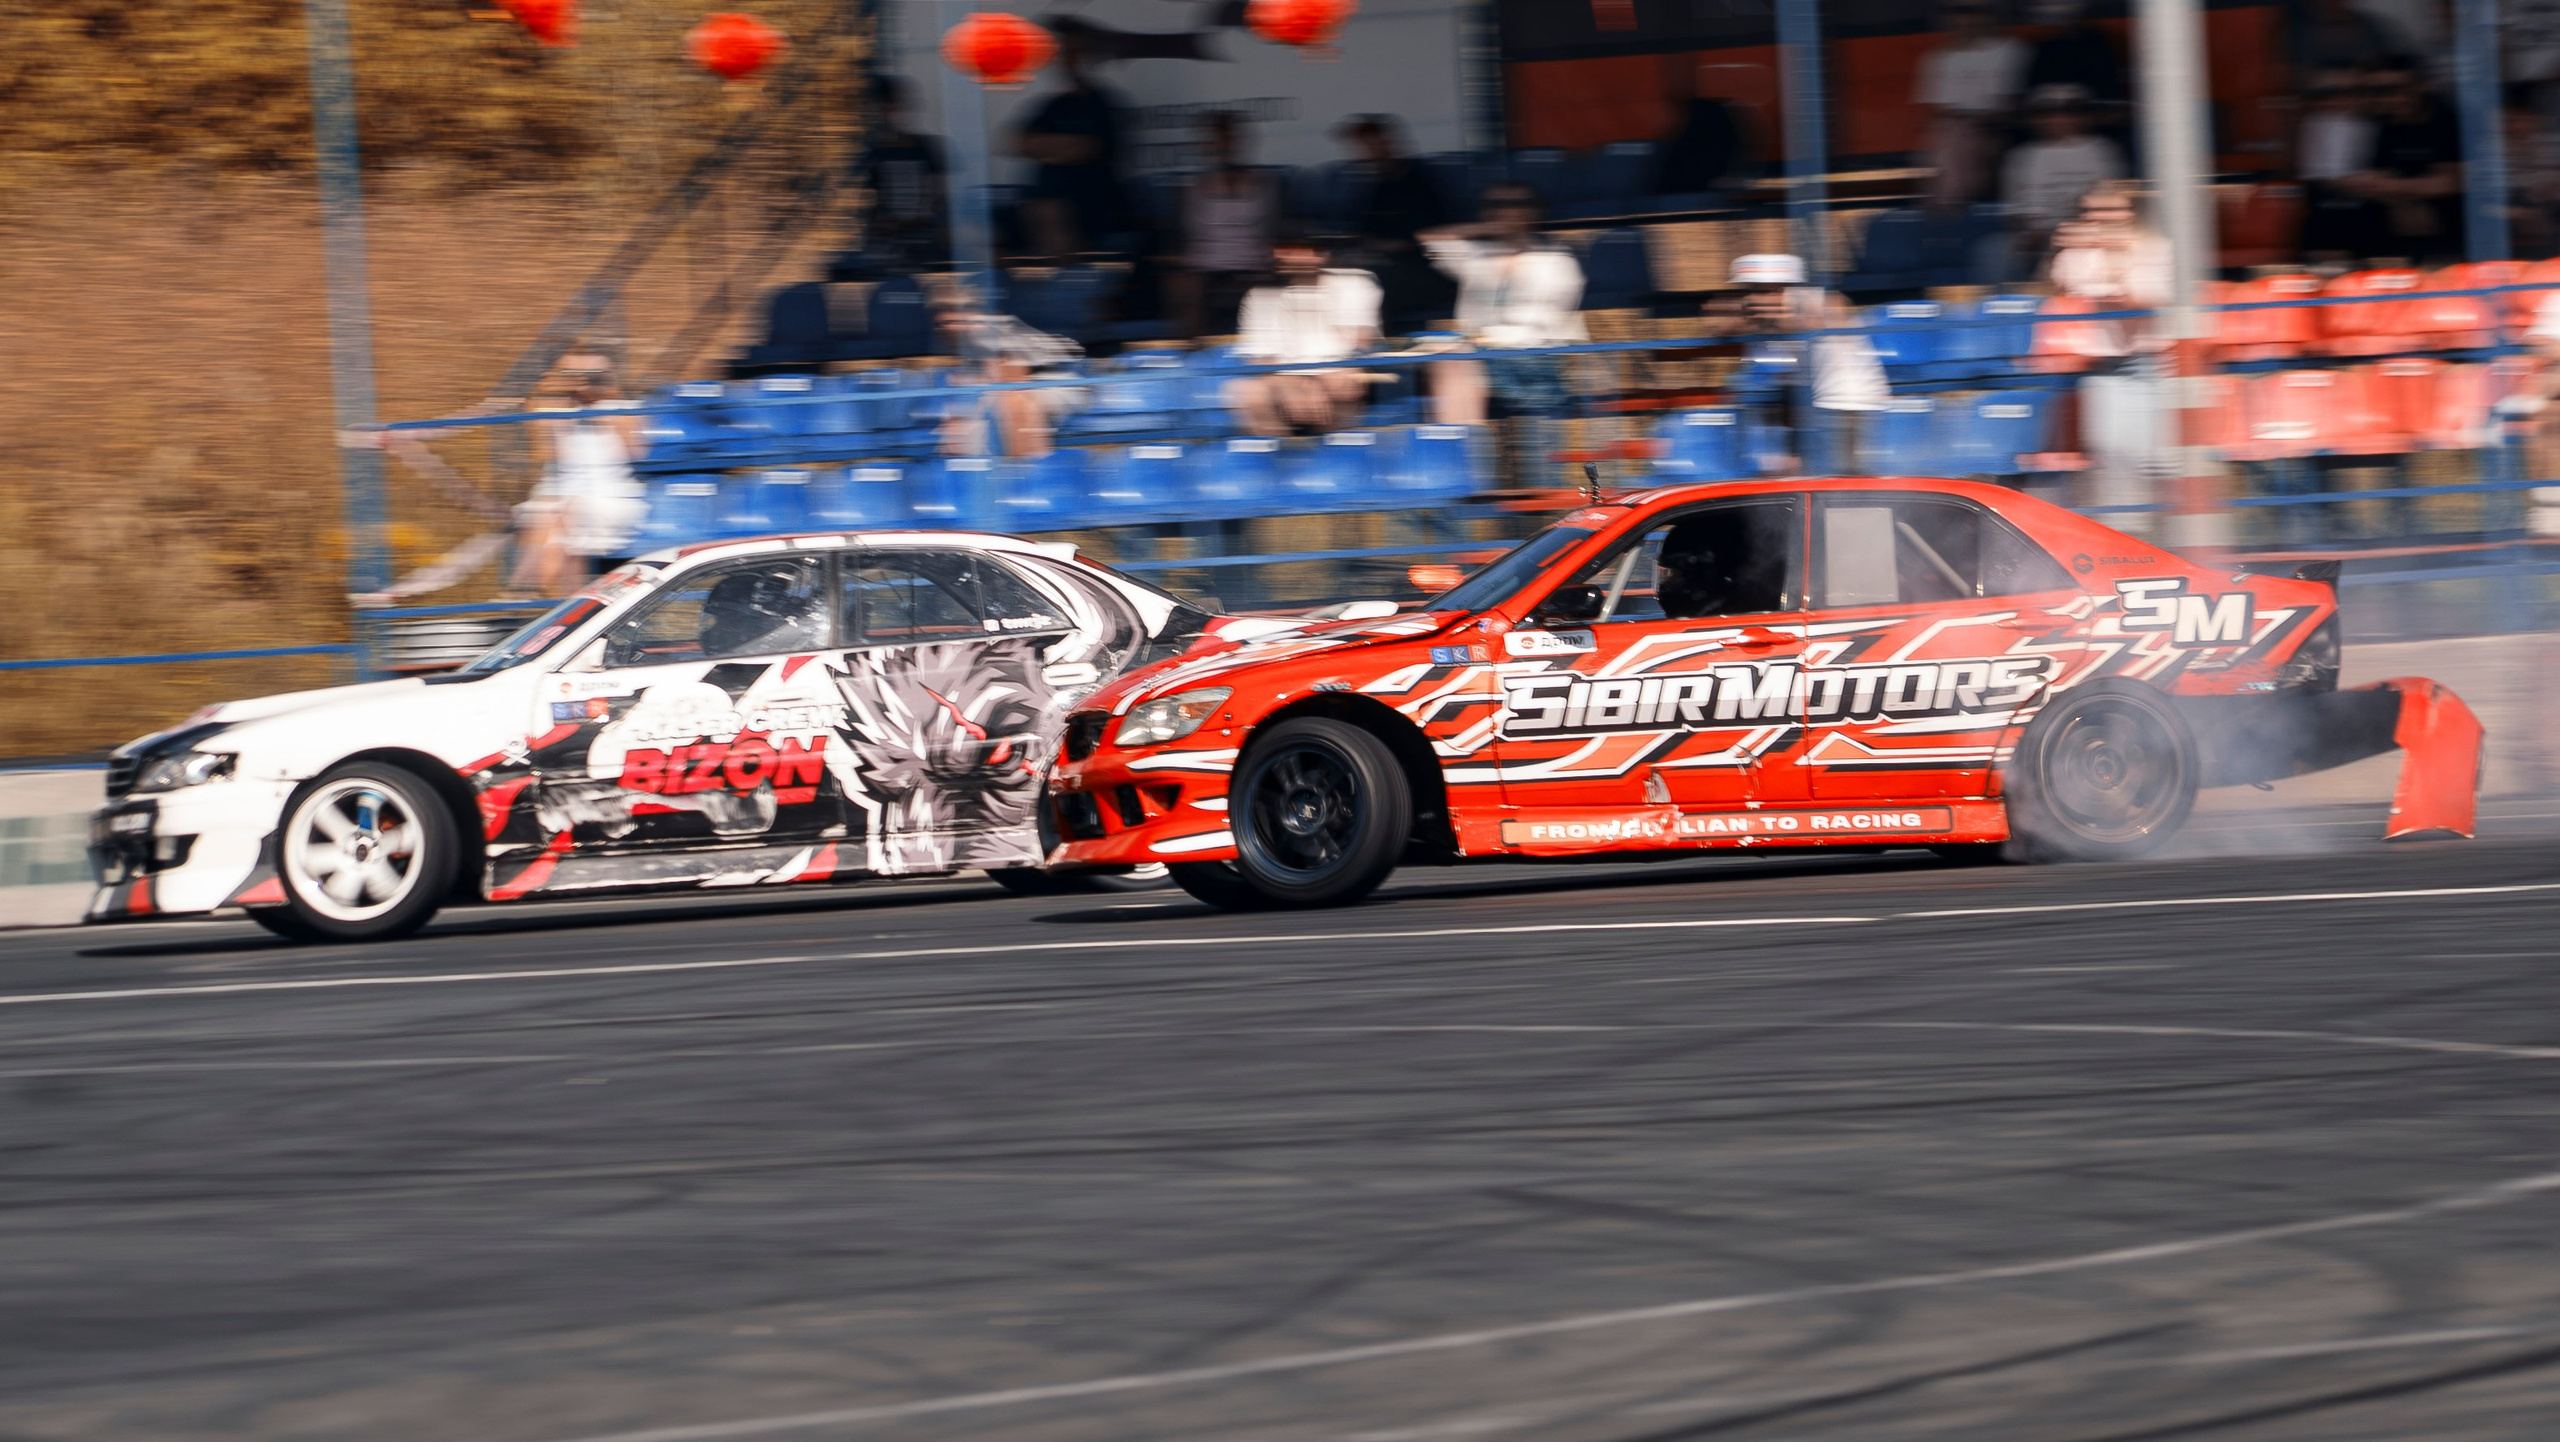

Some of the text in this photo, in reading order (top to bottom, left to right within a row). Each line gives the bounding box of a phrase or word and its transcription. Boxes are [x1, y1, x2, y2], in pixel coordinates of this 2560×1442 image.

[2116, 579, 2247, 643] SM
[1431, 646, 1489, 664] SKR
[618, 736, 827, 795] BIZON
[1764, 815, 1797, 831] TO
[1811, 813, 1922, 829] RACING
